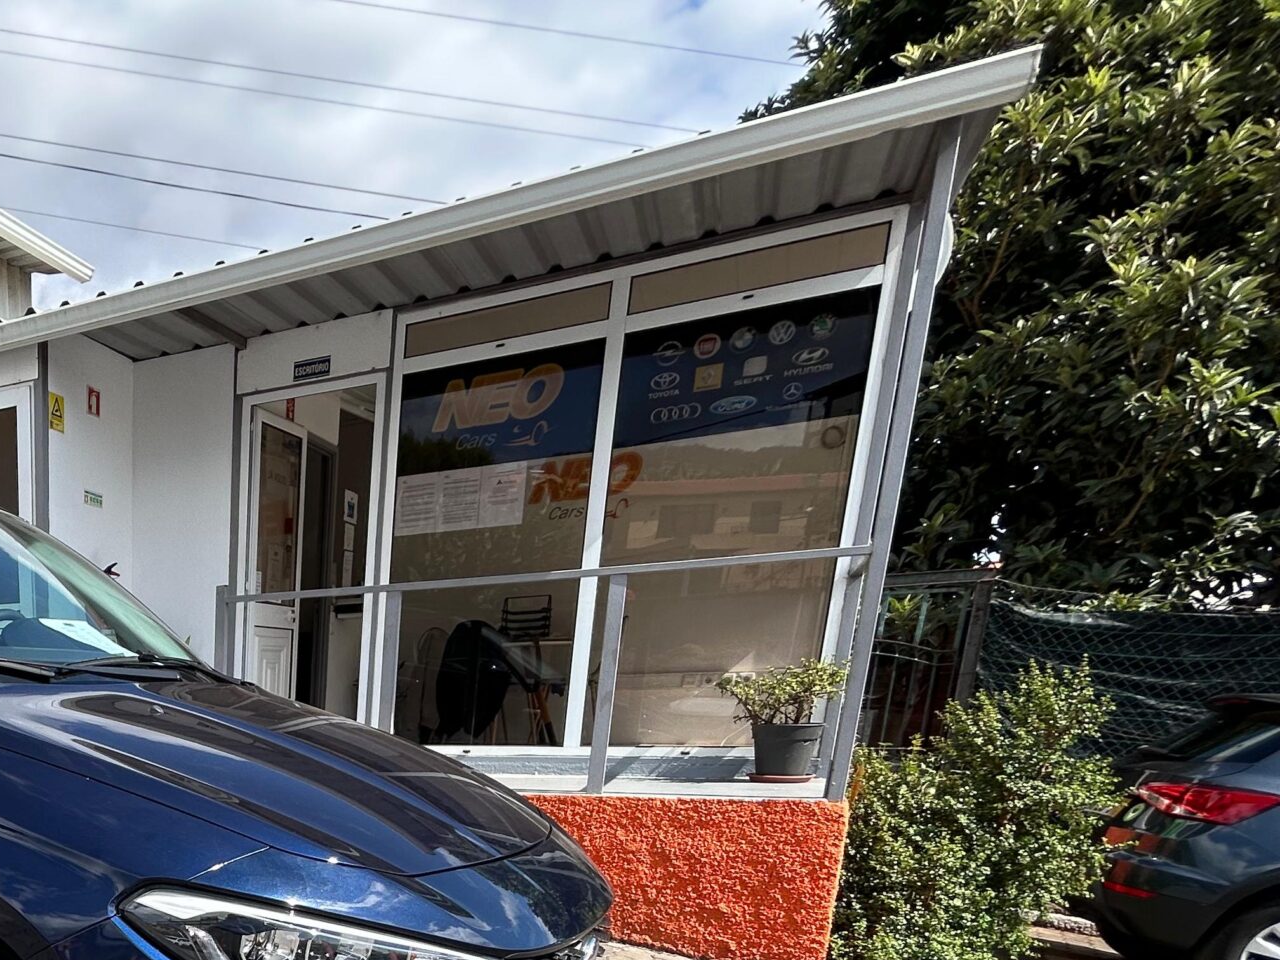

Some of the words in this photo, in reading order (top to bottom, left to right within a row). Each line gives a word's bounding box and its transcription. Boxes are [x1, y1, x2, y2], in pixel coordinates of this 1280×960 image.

[784, 362, 834, 377] HYUNDAI
[733, 374, 773, 386] SEAT
[432, 363, 565, 433] NEO
[648, 389, 680, 400] TOYOTA
[456, 432, 497, 450] Cars
[548, 505, 584, 521] Cars
